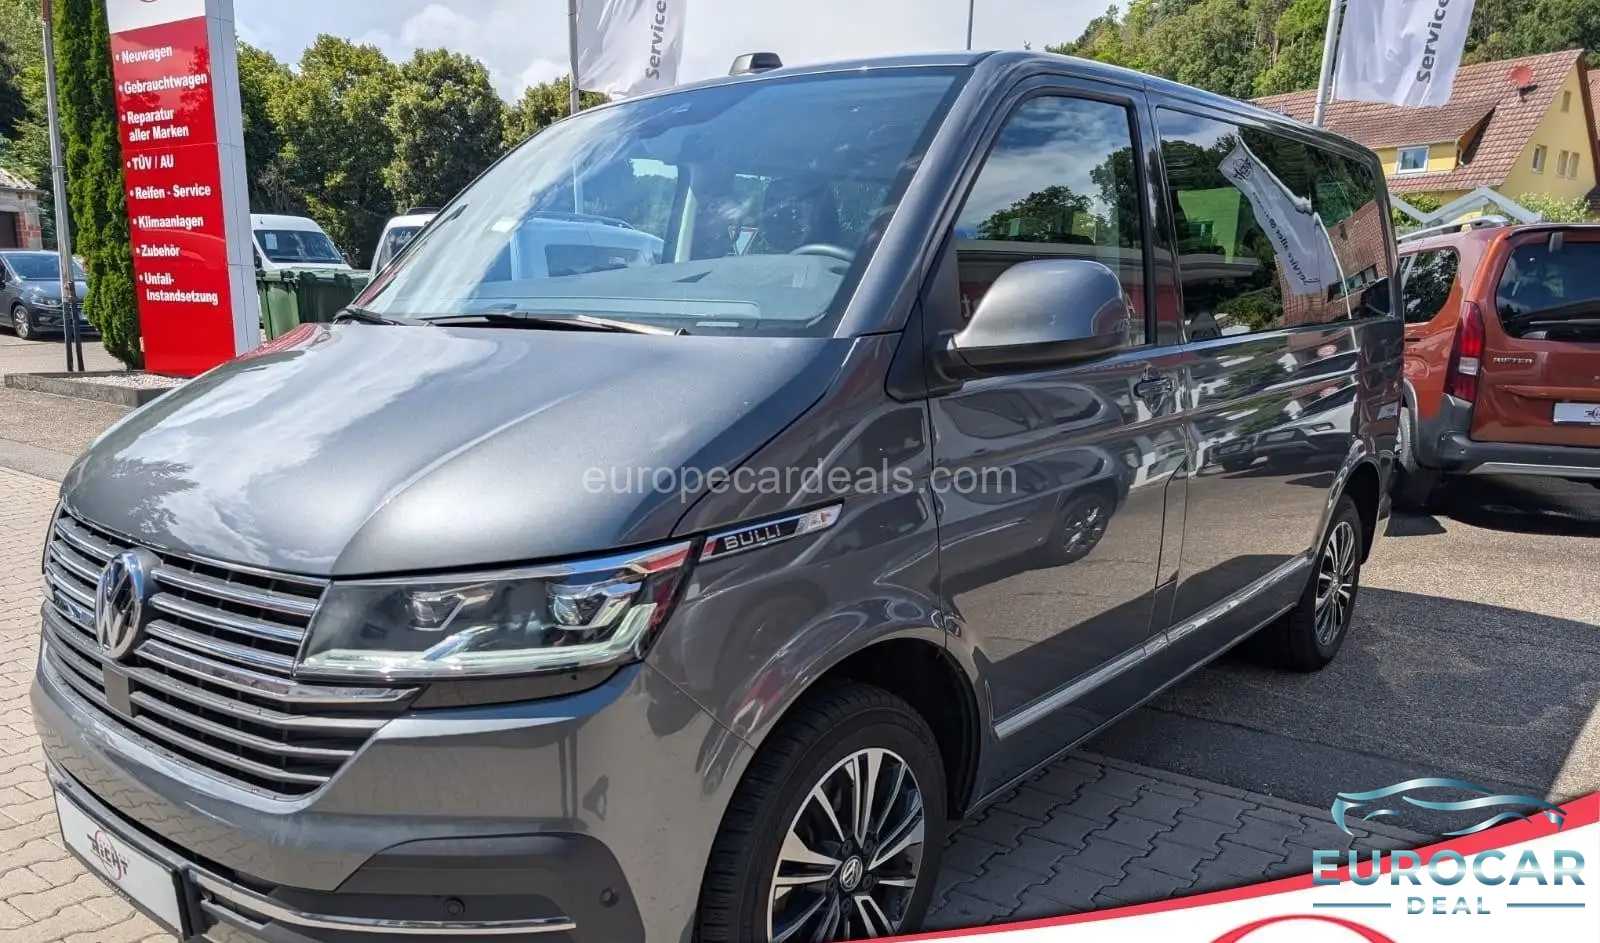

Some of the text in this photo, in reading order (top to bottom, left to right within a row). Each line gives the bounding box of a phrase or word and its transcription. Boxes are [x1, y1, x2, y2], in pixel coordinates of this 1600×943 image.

[645, 0, 667, 80] Service
[1416, 0, 1450, 84] Service
[121, 45, 172, 64] Neuwagen
[124, 72, 207, 95] Gebrauchtwagen
[127, 107, 175, 126] Reparatur
[129, 125, 189, 141] aller Marken
[131, 155, 152, 171] TÜV
[160, 155, 174, 169] AU
[135, 186, 165, 200] Reifen
[172, 184, 211, 198] Service
[138, 215, 204, 230] Klimaanlagen
[141, 245, 180, 259] Zubehör
[146, 289, 218, 306] Instandsetzung
[724, 524, 781, 550] BULLI
